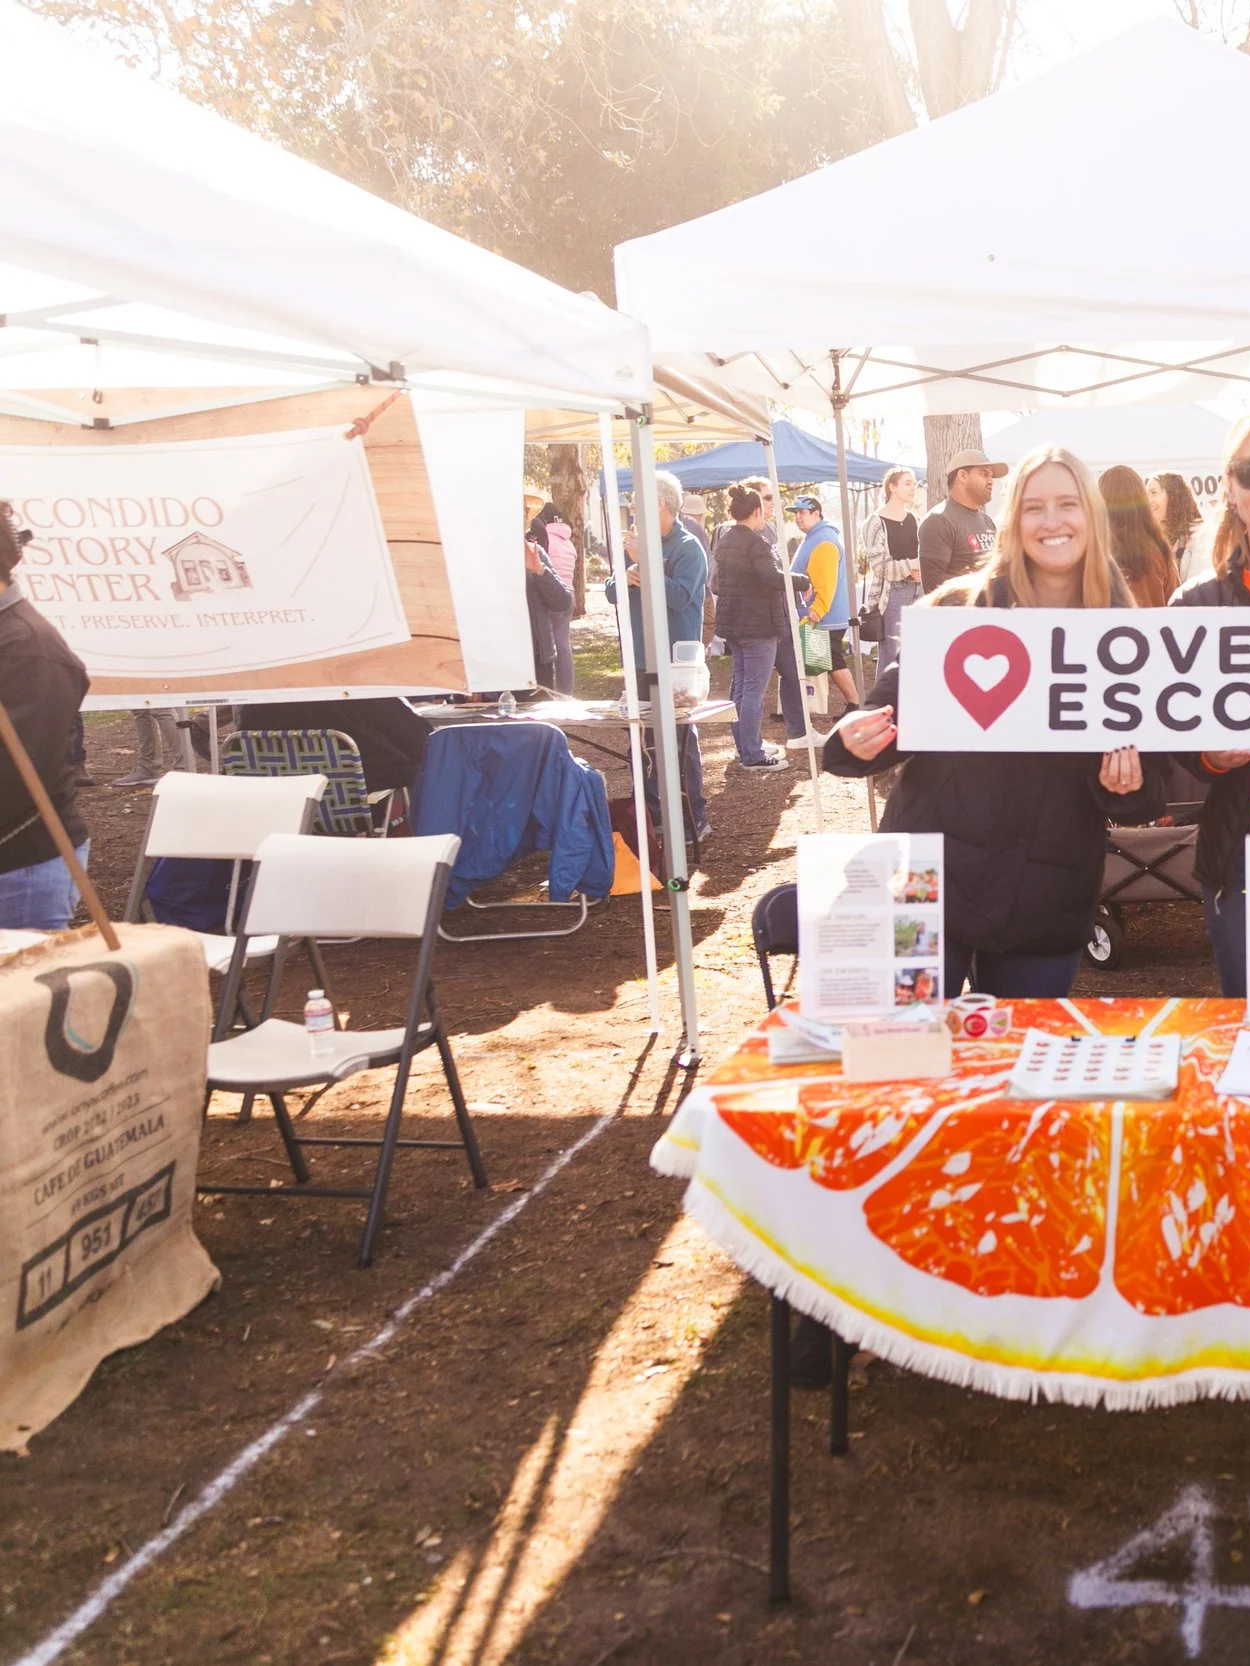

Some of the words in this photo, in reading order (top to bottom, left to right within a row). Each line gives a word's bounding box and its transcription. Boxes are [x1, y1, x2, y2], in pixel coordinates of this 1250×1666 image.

[22, 536, 159, 566] STORY
[22, 572, 162, 602] ENTER
[82, 613, 191, 630] PRESERVE.
[195, 608, 316, 628] INTERPRET.
[83, 1114, 165, 1170] GUATEMALA
[81, 1221, 113, 1262] 951
